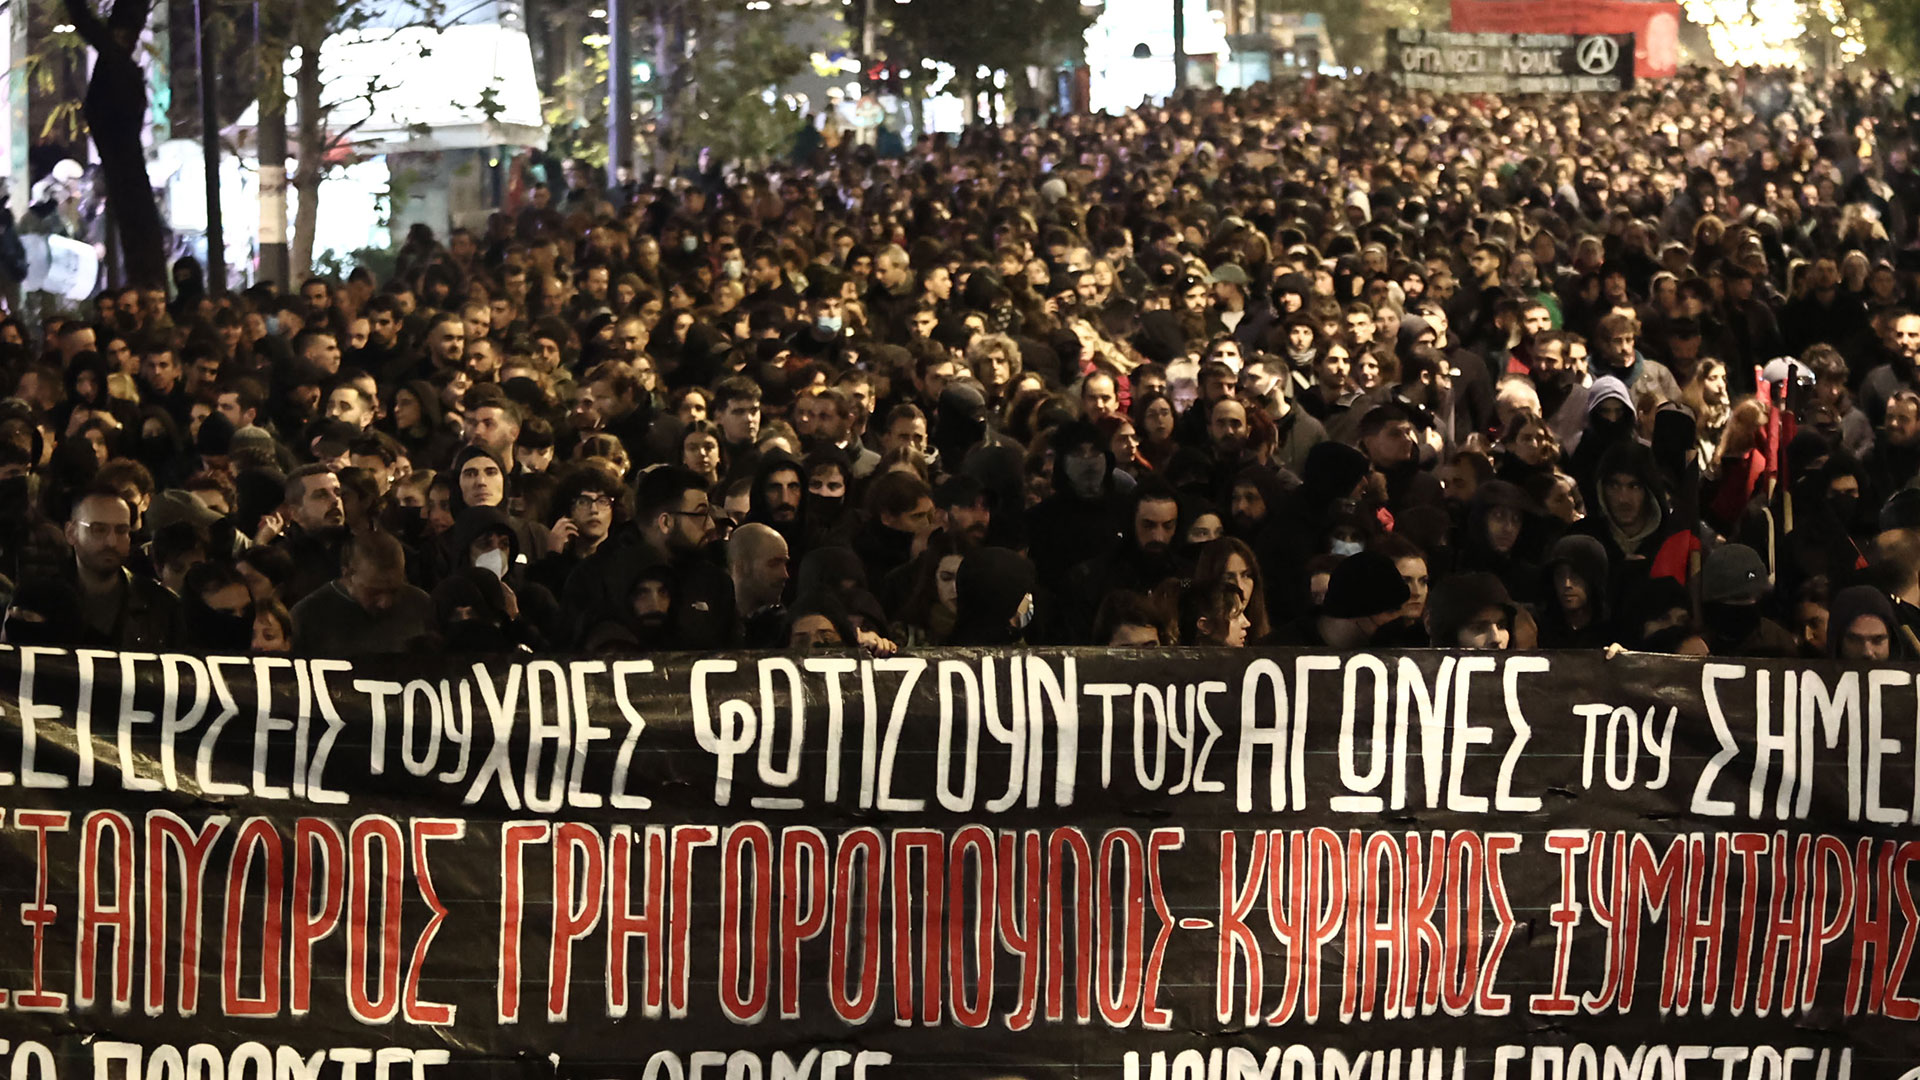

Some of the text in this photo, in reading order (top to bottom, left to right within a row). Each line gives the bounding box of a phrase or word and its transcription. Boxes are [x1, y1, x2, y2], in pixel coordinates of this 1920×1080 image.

[0, 644, 1920, 825] ΕΓΕΡΣΕΙΣ ΤΟΥ ΧΘΕΣ ΦΩΤΙΖΟΥΝ ΤΟΥΣ ΑΓΩΝΕΣ ΤΟΥ ΣΗΜΕ
[0, 808, 467, 1027] ΞΑΝΔΡΟΣ
